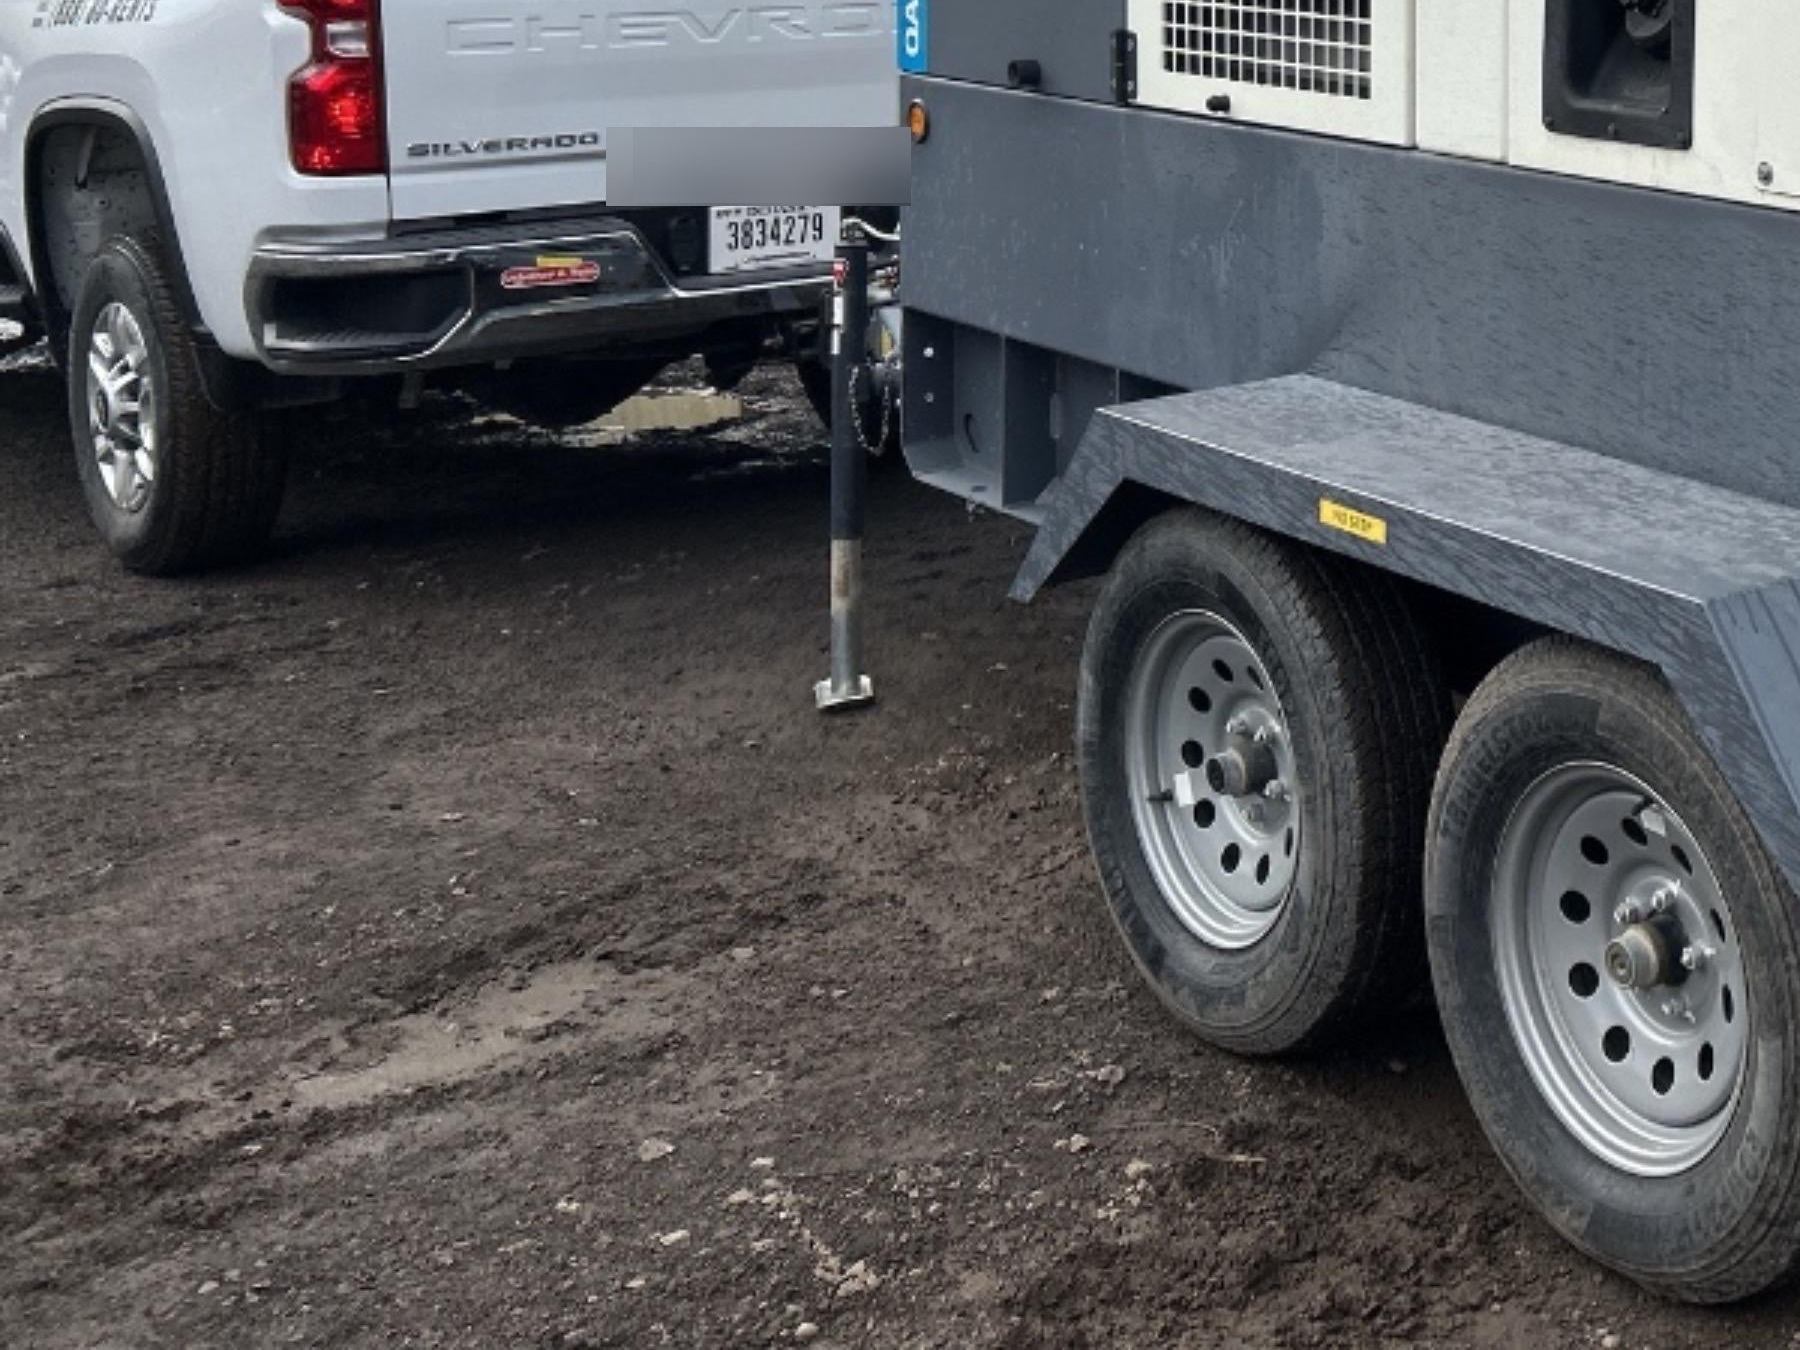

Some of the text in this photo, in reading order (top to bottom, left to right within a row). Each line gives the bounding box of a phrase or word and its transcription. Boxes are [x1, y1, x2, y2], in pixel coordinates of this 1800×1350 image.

[446, 2, 898, 54] CHEVRO
[406, 131, 599, 157] SILVERADO
[726, 212, 823, 250] 3834279
